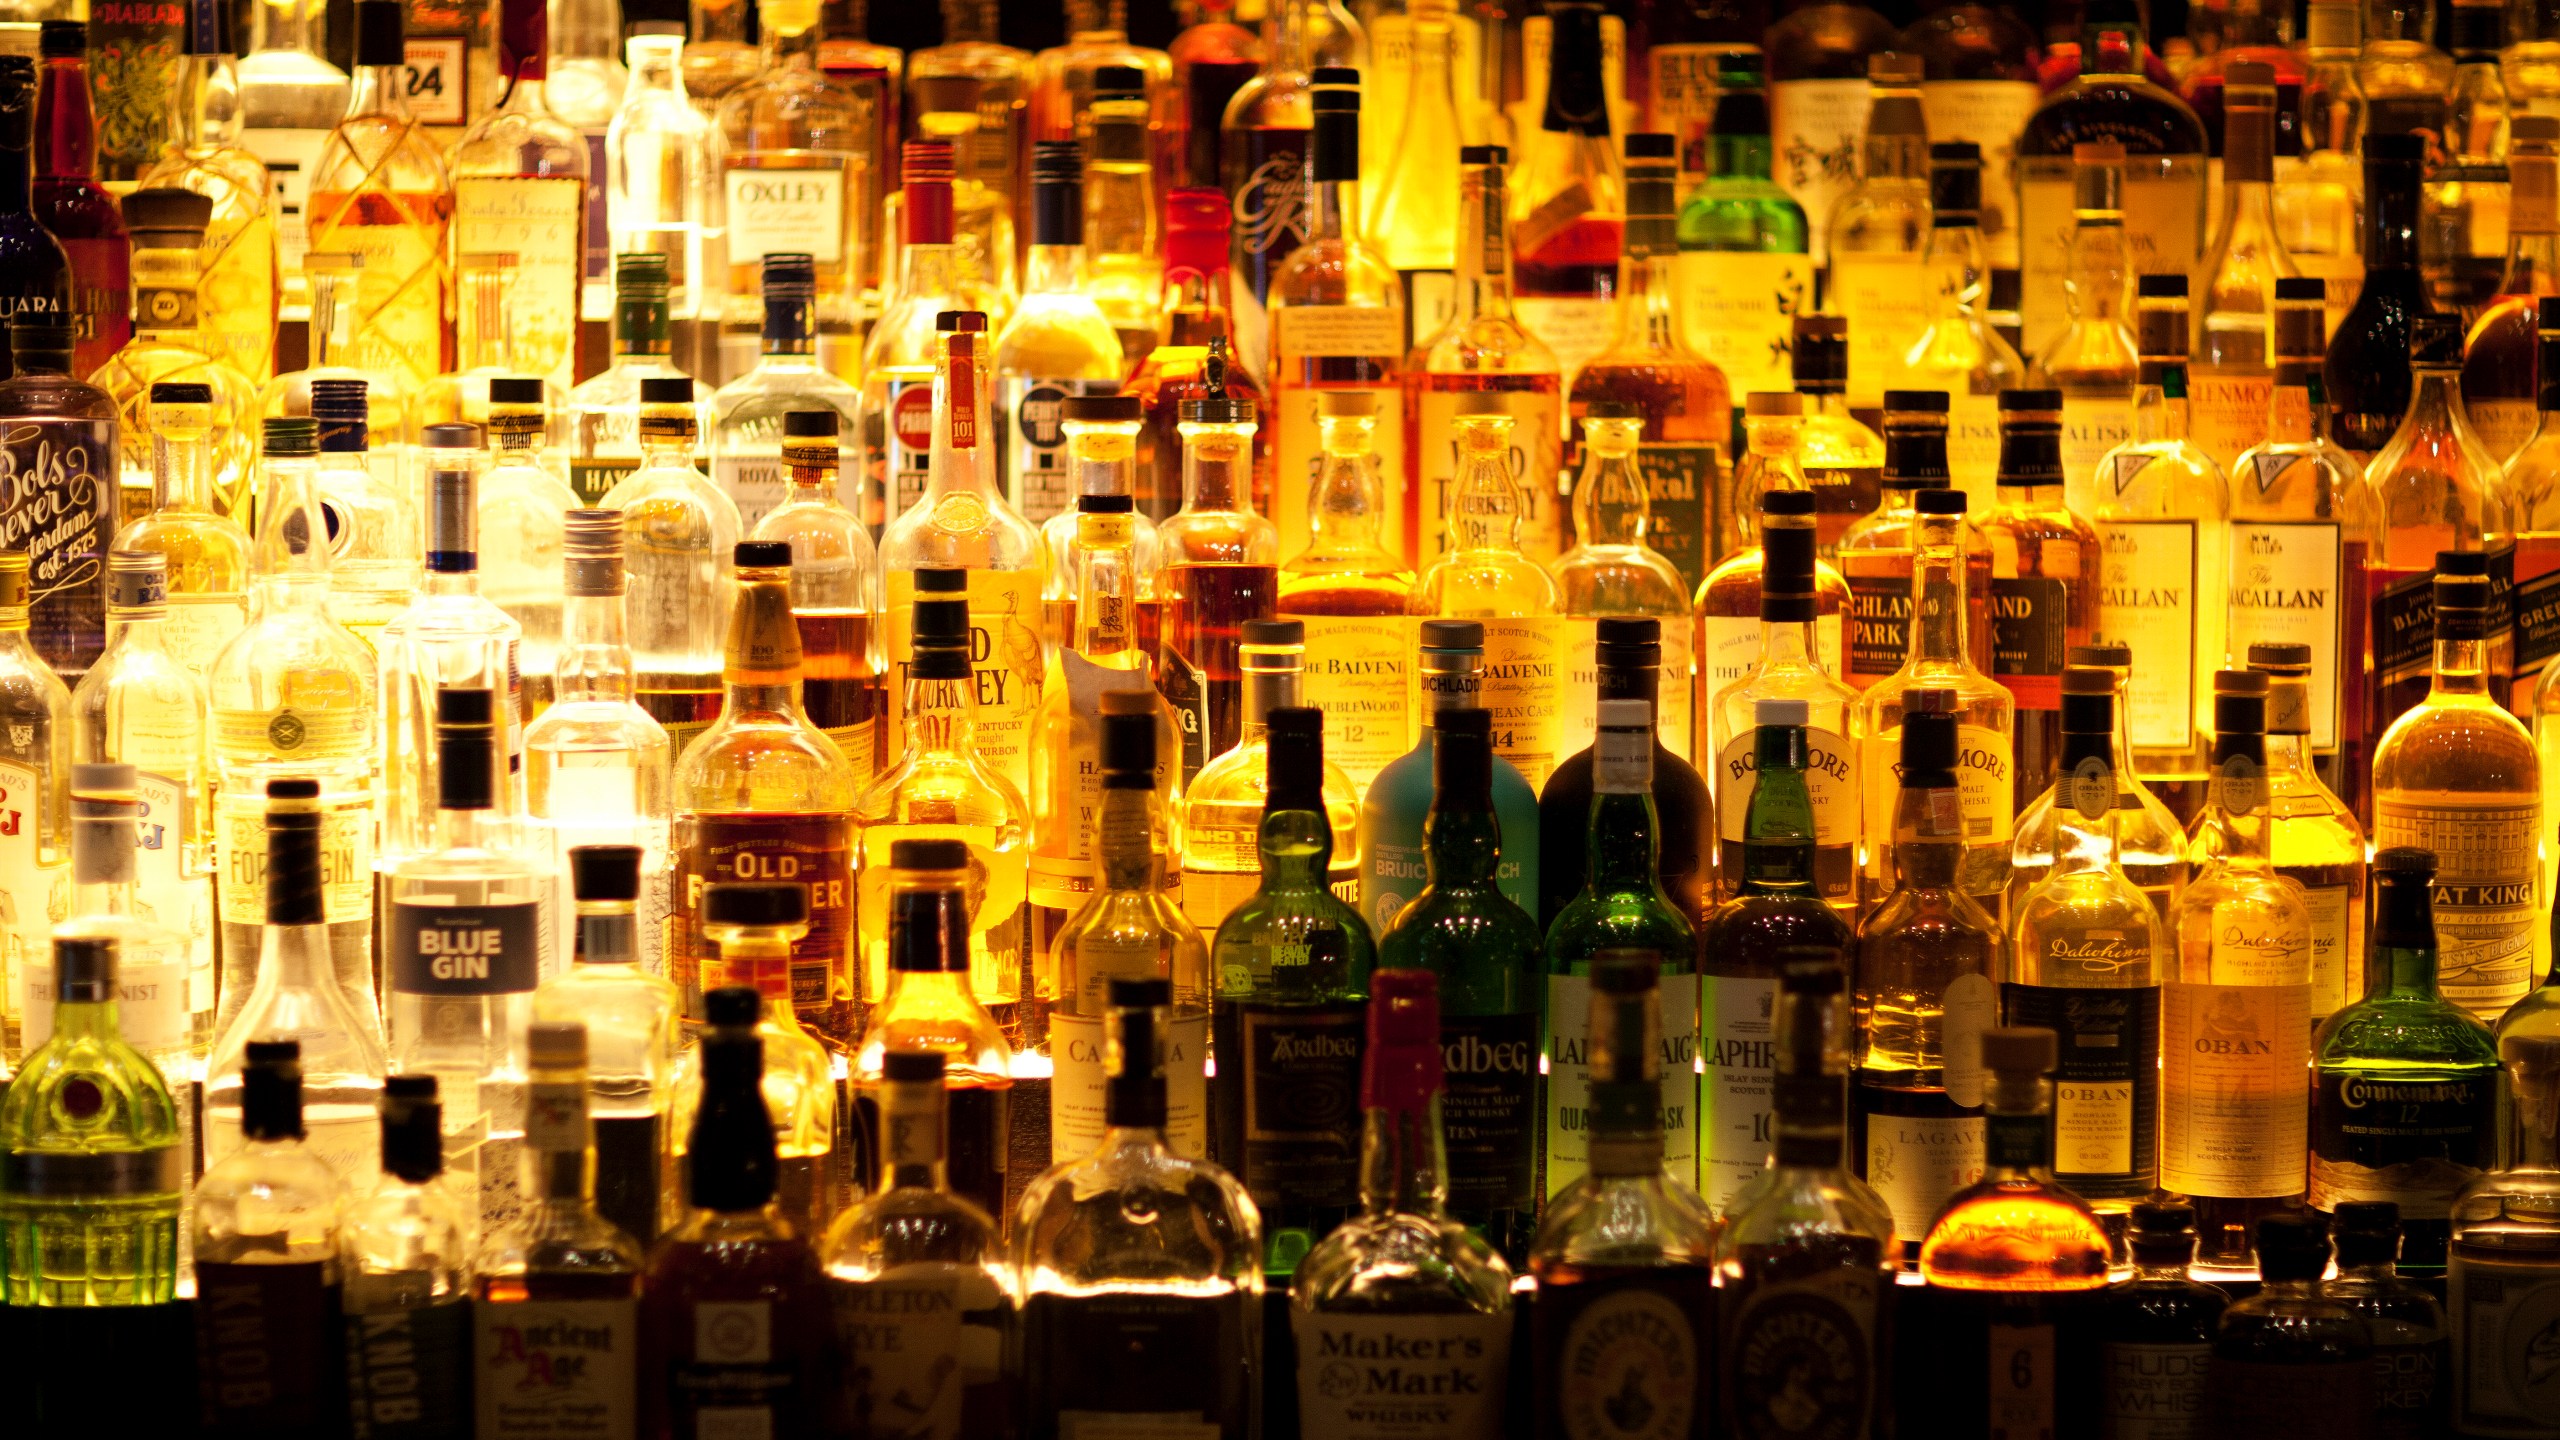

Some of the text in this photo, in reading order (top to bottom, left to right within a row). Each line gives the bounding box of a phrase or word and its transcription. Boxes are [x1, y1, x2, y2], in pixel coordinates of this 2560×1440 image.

[738, 181, 829, 204] OXLEY
[952, 421, 975, 438] 101
[738, 467, 780, 484] ROYA
[37, 526, 98, 581] est. 1575
[2100, 588, 2180, 608] CALLAN
[1347, 624, 1383, 635] SCOTCH
[1496, 628, 1531, 638] SCOTCH
[1852, 622, 1902, 645] PARK
[751, 645, 774, 655] 100
[1304, 658, 1405, 675] HE BALVENI
[1714, 665, 1742, 679] THE
[1527, 703, 1555, 718] CASK
[975, 720, 1023, 732] ENTUCKY
[1342, 725, 1364, 743] 12
[1492, 730, 1516, 748] 14
[1961, 785, 1985, 794] MALT
[2078, 784, 2106, 792] OBAN
[2224, 780, 2253, 788] OBAN
[1964, 796, 1992, 806] HISKY
[734, 851, 800, 879] OLD
[2478, 884, 2532, 905] KING
[2457, 914, 2507, 924] SCOTCH
[418, 929, 502, 956] BLUE
[2489, 933, 2528, 957] BLEND
[430, 955, 490, 979] GIN
[1068, 1039, 1102, 1063] CA
[2193, 1037, 2273, 1056] OBAN
[1729, 1086, 1766, 1096] SCOTCH
[2059, 1087, 2130, 1101] OBAN
[2339, 1076, 2472, 1110] Connemara
[1467, 1107, 1513, 1119] WHISKY
[2399, 1104, 2421, 1124] 12
[1446, 1124, 1478, 1140] TEN
[2341, 1125, 2368, 1134] PEATED
[2368, 1126, 2398, 1135] SINGLE
[2398, 1127, 2420, 1136] MALT
[1950, 1167, 1982, 1187] 16
[489, 1319, 612, 1366] Ancient
[1319, 1330, 1483, 1361] Maker's
[362, 1311, 423, 1425] KNOB
[514, 1352, 588, 1390] Age
[2010, 1348, 2031, 1389] 6
[1365, 1366, 1481, 1394] Mark
[1344, 1408, 1454, 1425] WHISKY
